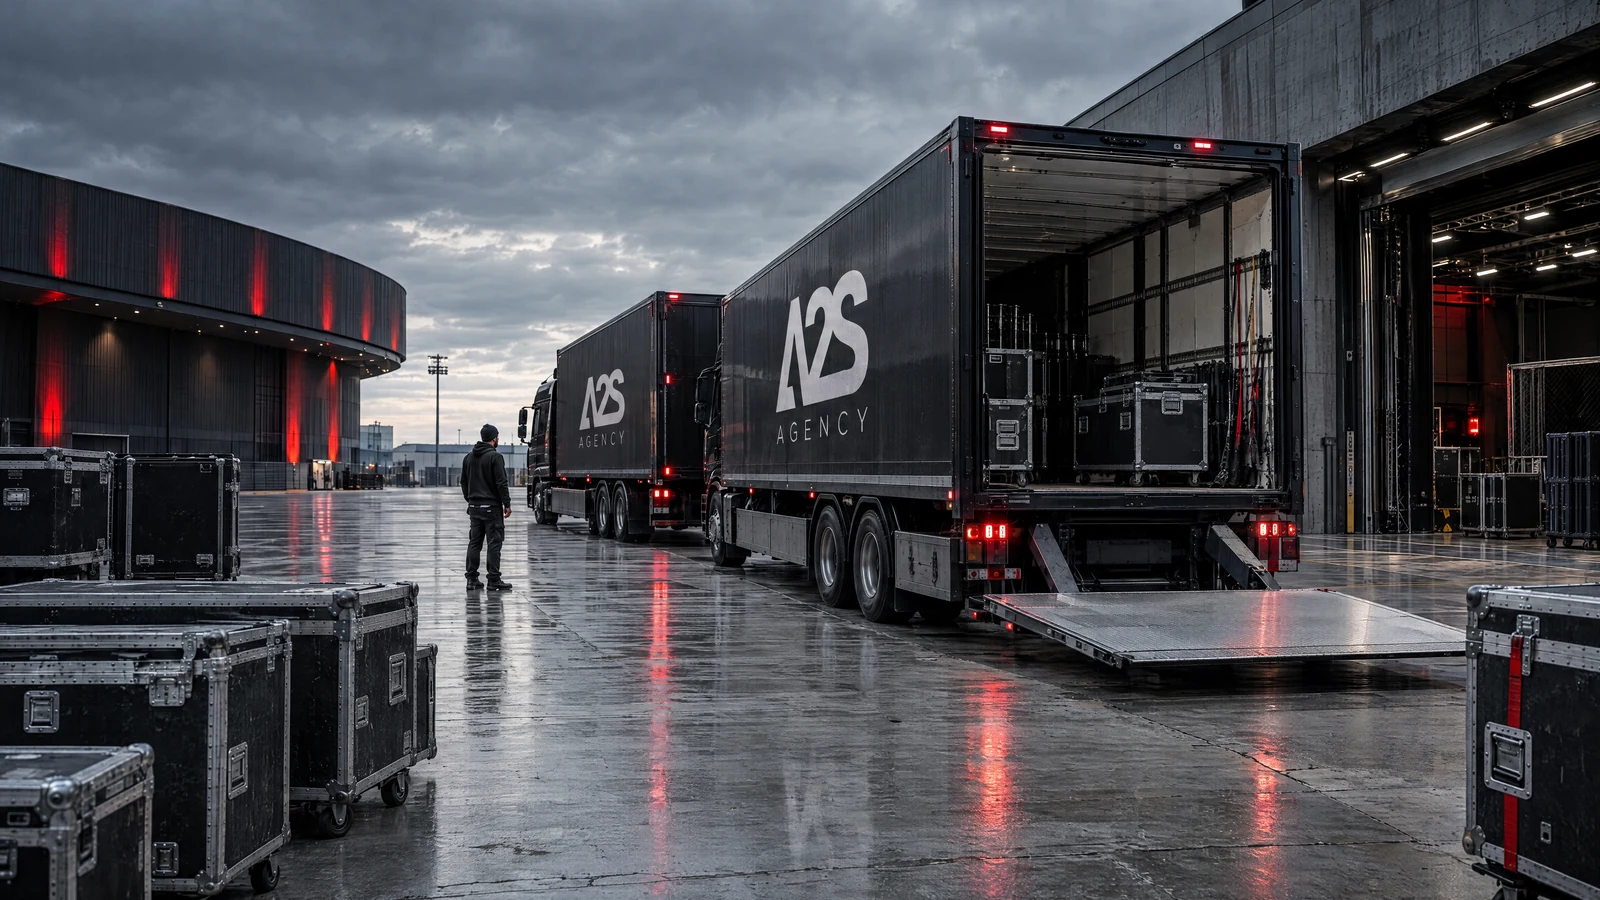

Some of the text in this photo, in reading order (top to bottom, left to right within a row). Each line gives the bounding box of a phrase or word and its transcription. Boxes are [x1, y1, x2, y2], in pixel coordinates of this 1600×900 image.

[776, 270, 868, 412] A2S
[579, 368, 625, 430] A2S
[578, 430, 625, 449] AGENCY
[776, 407, 868, 444] AGENCY
